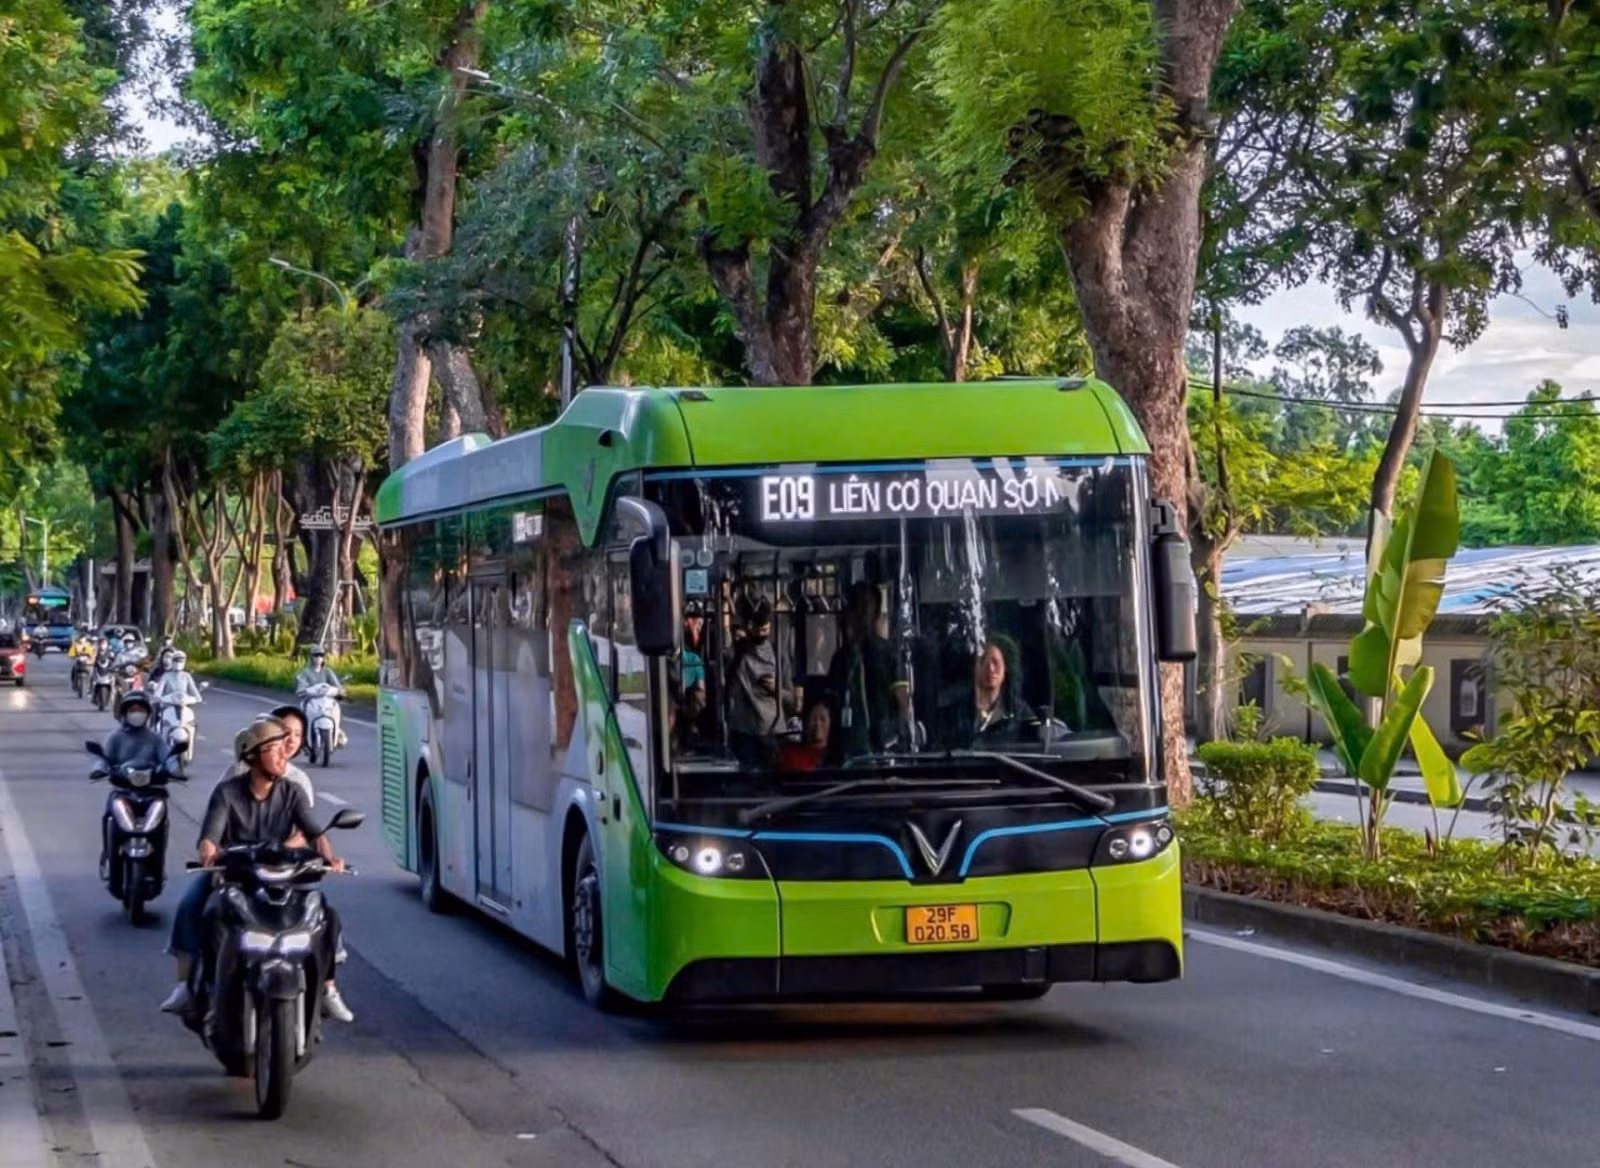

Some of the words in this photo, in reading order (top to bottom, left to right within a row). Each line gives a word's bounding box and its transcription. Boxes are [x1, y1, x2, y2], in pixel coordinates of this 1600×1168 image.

[762, 475, 815, 520] E09
[829, 474, 881, 513] LIÊN
[886, 477, 920, 512] CƠ
[926, 477, 997, 515] QUAN
[926, 907, 956, 924] 29F
[914, 924, 970, 942] 020.58
